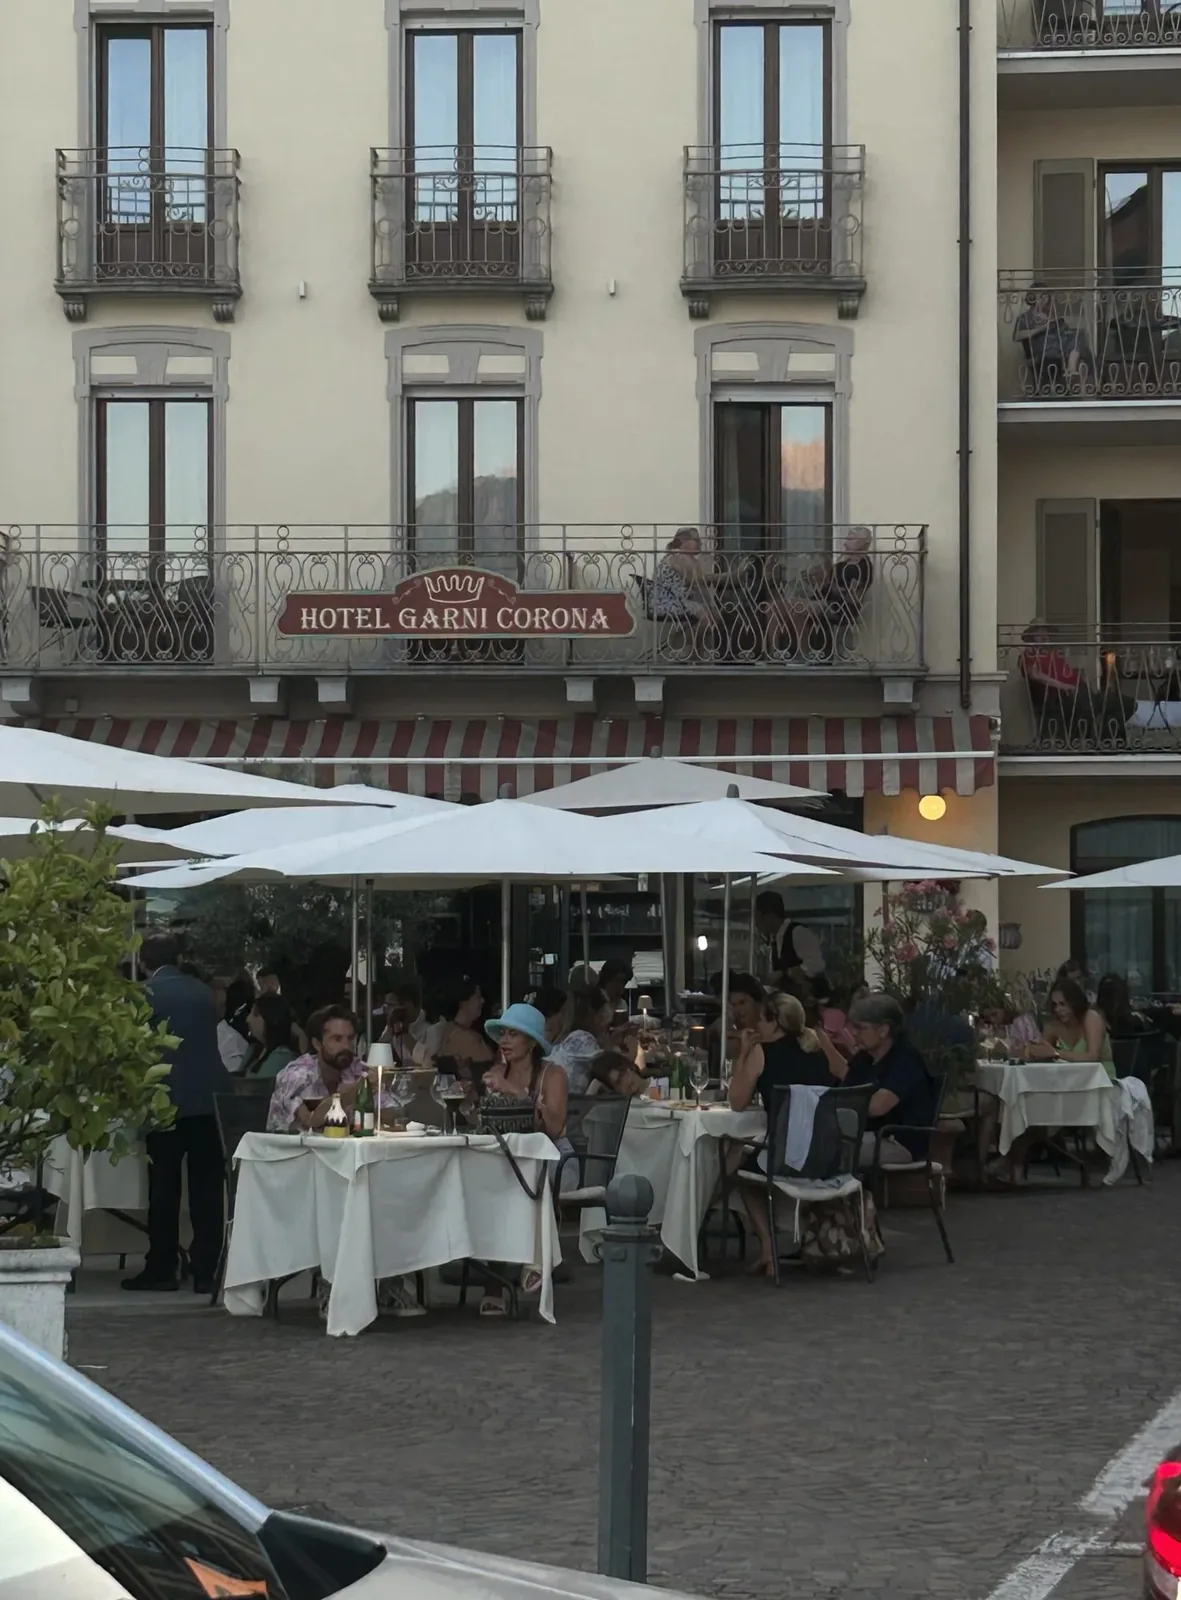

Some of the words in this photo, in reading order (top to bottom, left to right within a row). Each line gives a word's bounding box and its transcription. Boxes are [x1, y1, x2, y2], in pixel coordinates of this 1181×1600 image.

[301, 607, 391, 629] HOTEL
[398, 607, 487, 630] GARNI
[496, 607, 610, 630] CORONA
